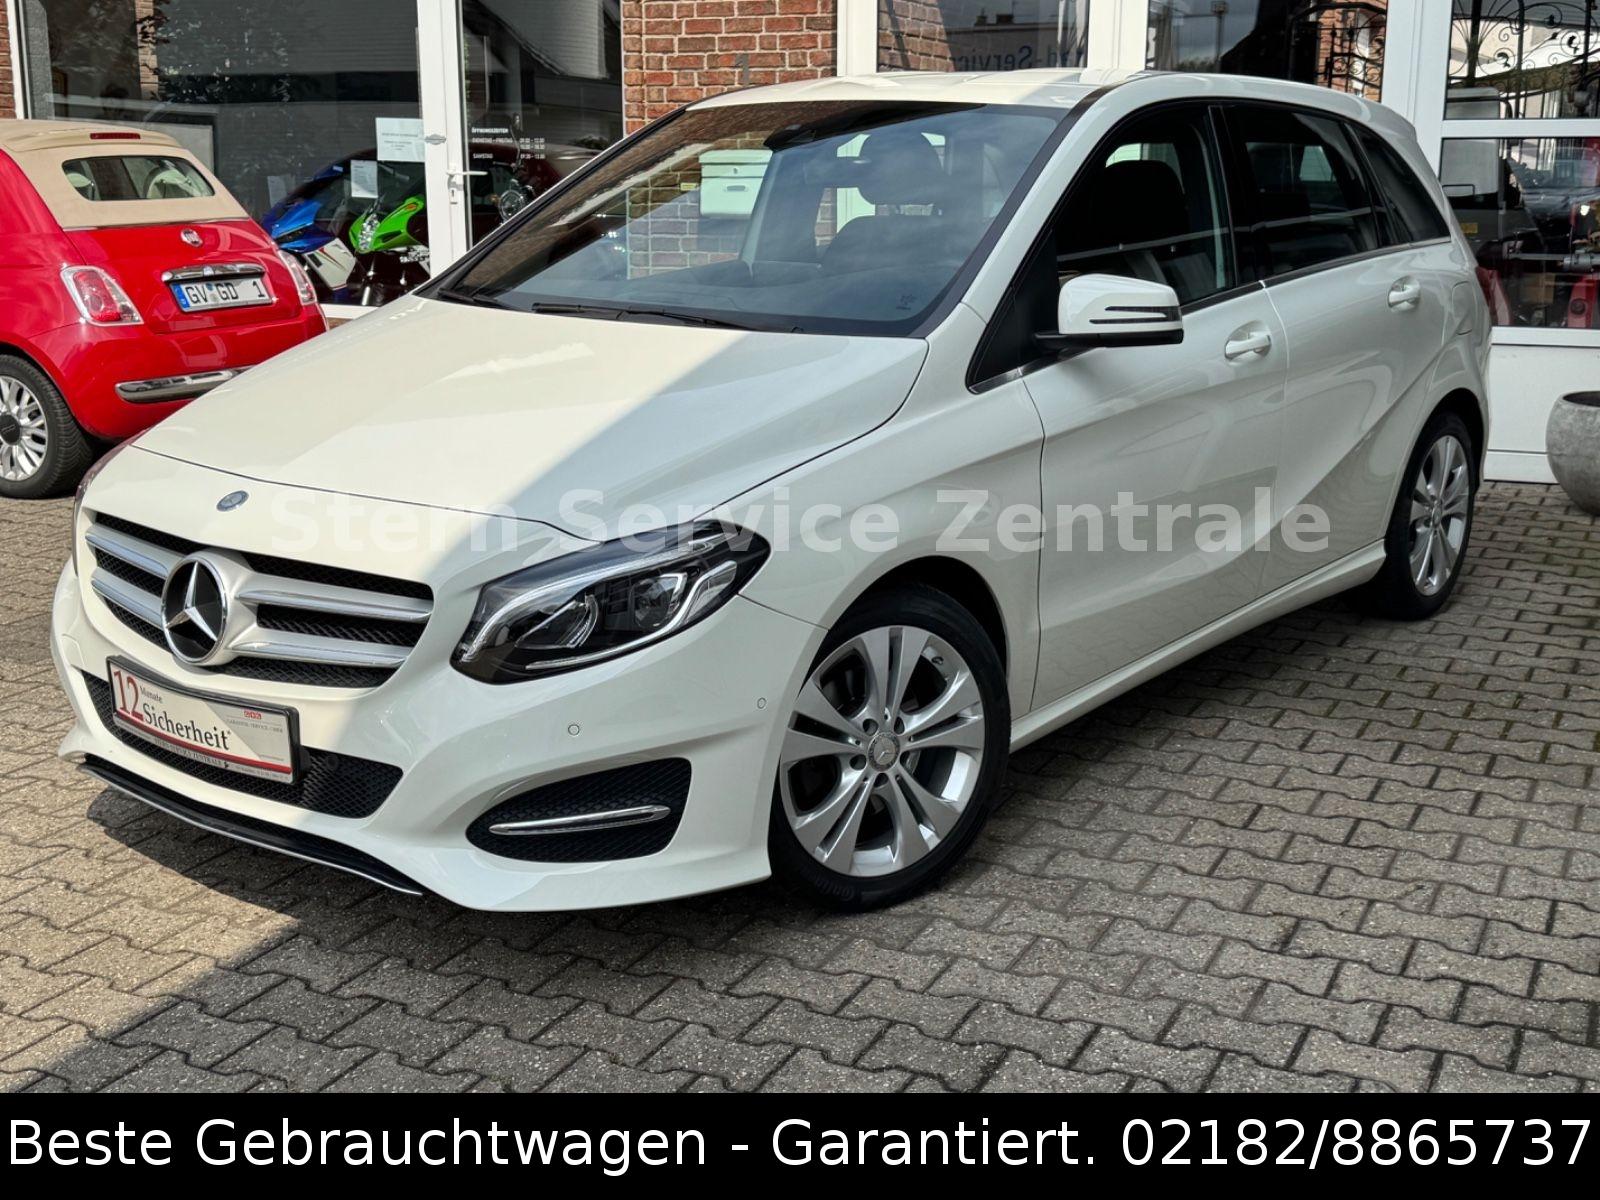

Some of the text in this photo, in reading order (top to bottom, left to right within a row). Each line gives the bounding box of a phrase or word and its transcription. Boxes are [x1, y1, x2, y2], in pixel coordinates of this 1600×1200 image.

[185, 286, 208, 304] GV
[215, 282, 239, 301] GD
[252, 280, 265, 298] 1
[113, 670, 144, 722] 12
